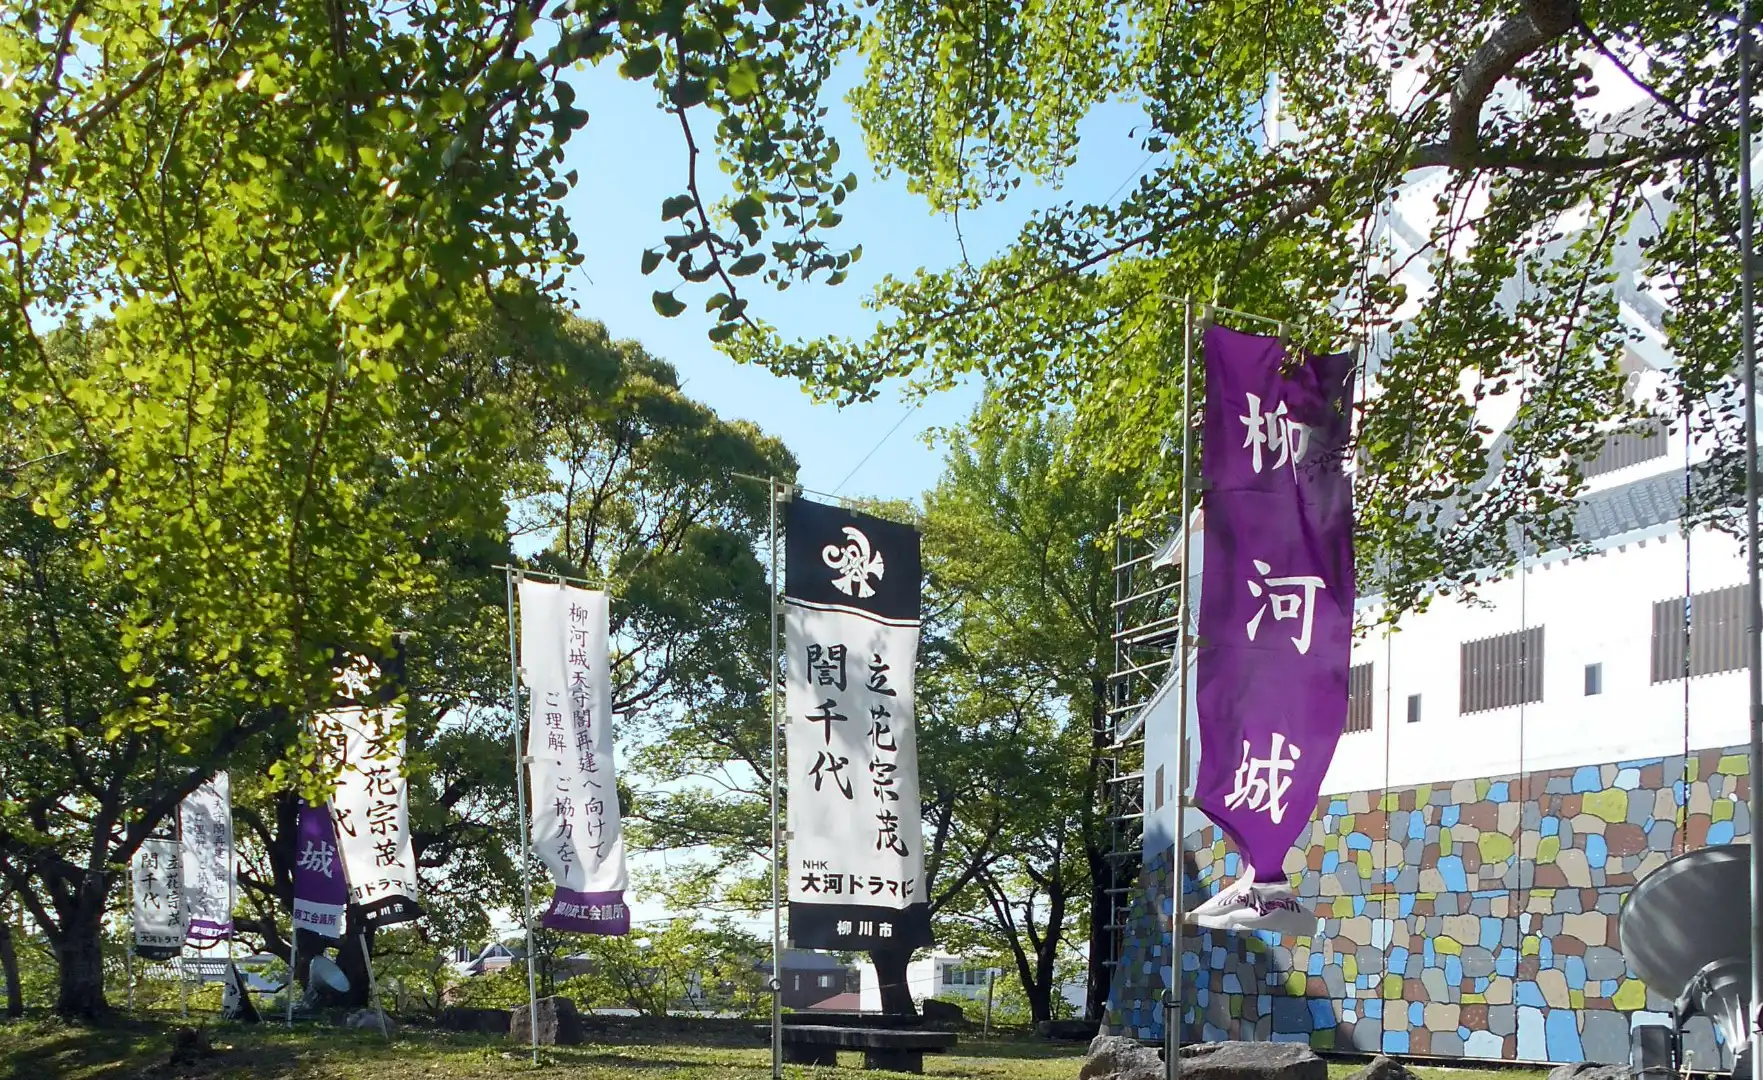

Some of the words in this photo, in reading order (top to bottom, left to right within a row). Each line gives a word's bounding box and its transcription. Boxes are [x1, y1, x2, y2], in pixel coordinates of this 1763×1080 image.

[1225, 392, 1325, 825] 柳河城
[568, 601, 606, 859] 柳河城天守閣再建へ向けて
[804, 643, 854, 800] 誾千代
[865, 653, 910, 858] 立花宗茂
[297, 840, 336, 879] 城
[801, 872, 914, 899] 大河ドラマに
[802, 859, 829, 870] NHK
[165, 854, 183, 929] 立花宗茂
[366, 902, 404, 921] 柳川市
[836, 919, 893, 938] 柳川市
